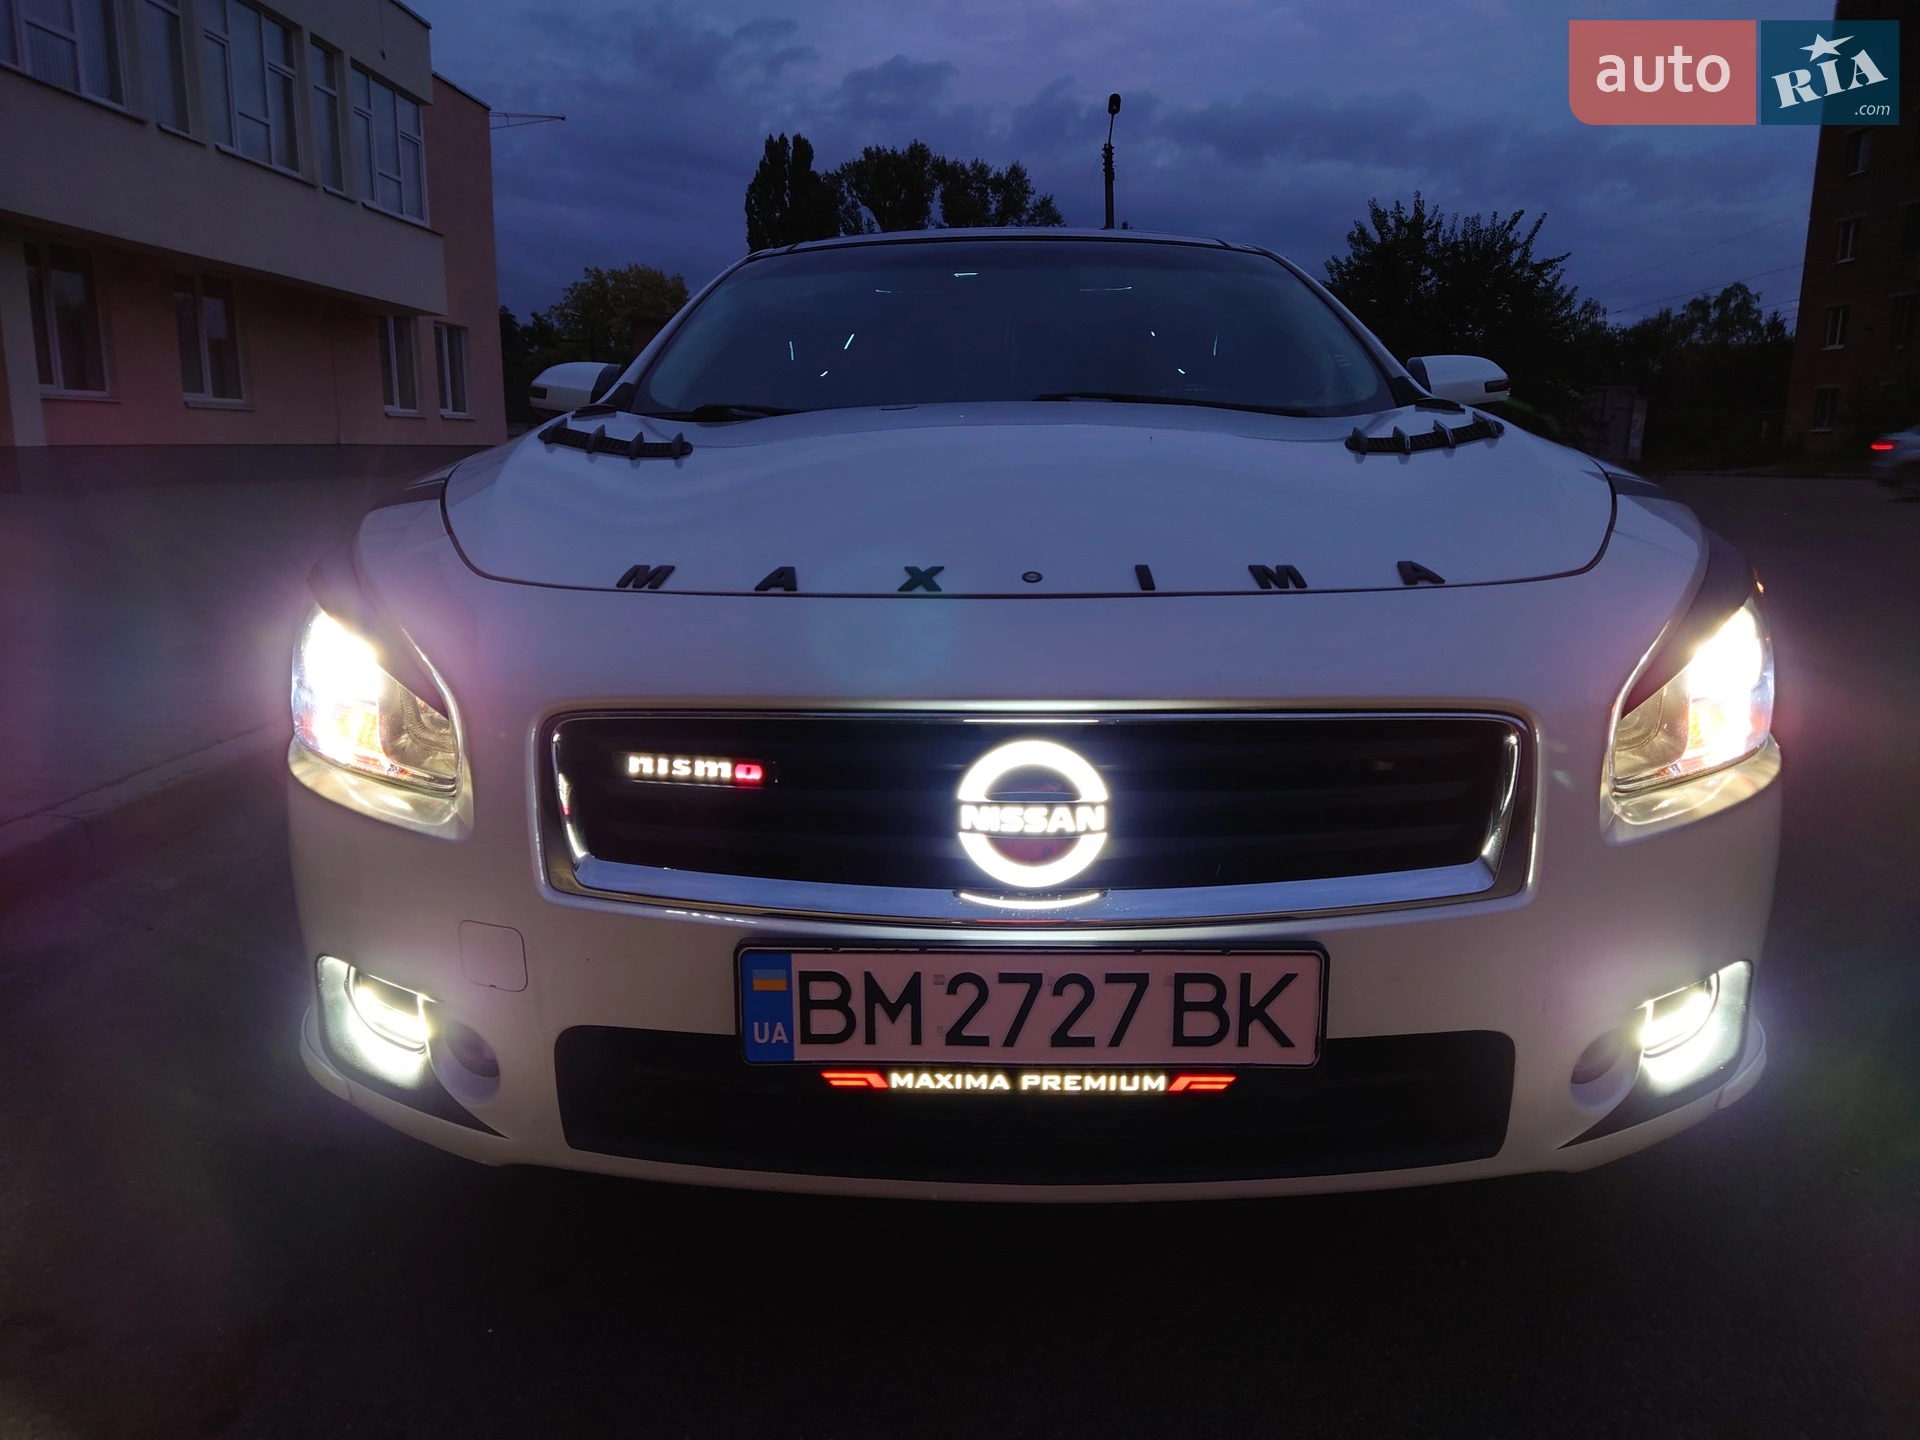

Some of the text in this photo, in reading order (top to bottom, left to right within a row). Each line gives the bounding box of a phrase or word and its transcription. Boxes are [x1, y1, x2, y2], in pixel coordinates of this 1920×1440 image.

[628, 755, 763, 780] nismo
[961, 804, 1105, 833] NISSAN
[799, 970, 1299, 1048] BM 2727 BK
[753, 1021, 789, 1045] UA
[890, 1072, 1166, 1092] MAXIMA PREMIUM
